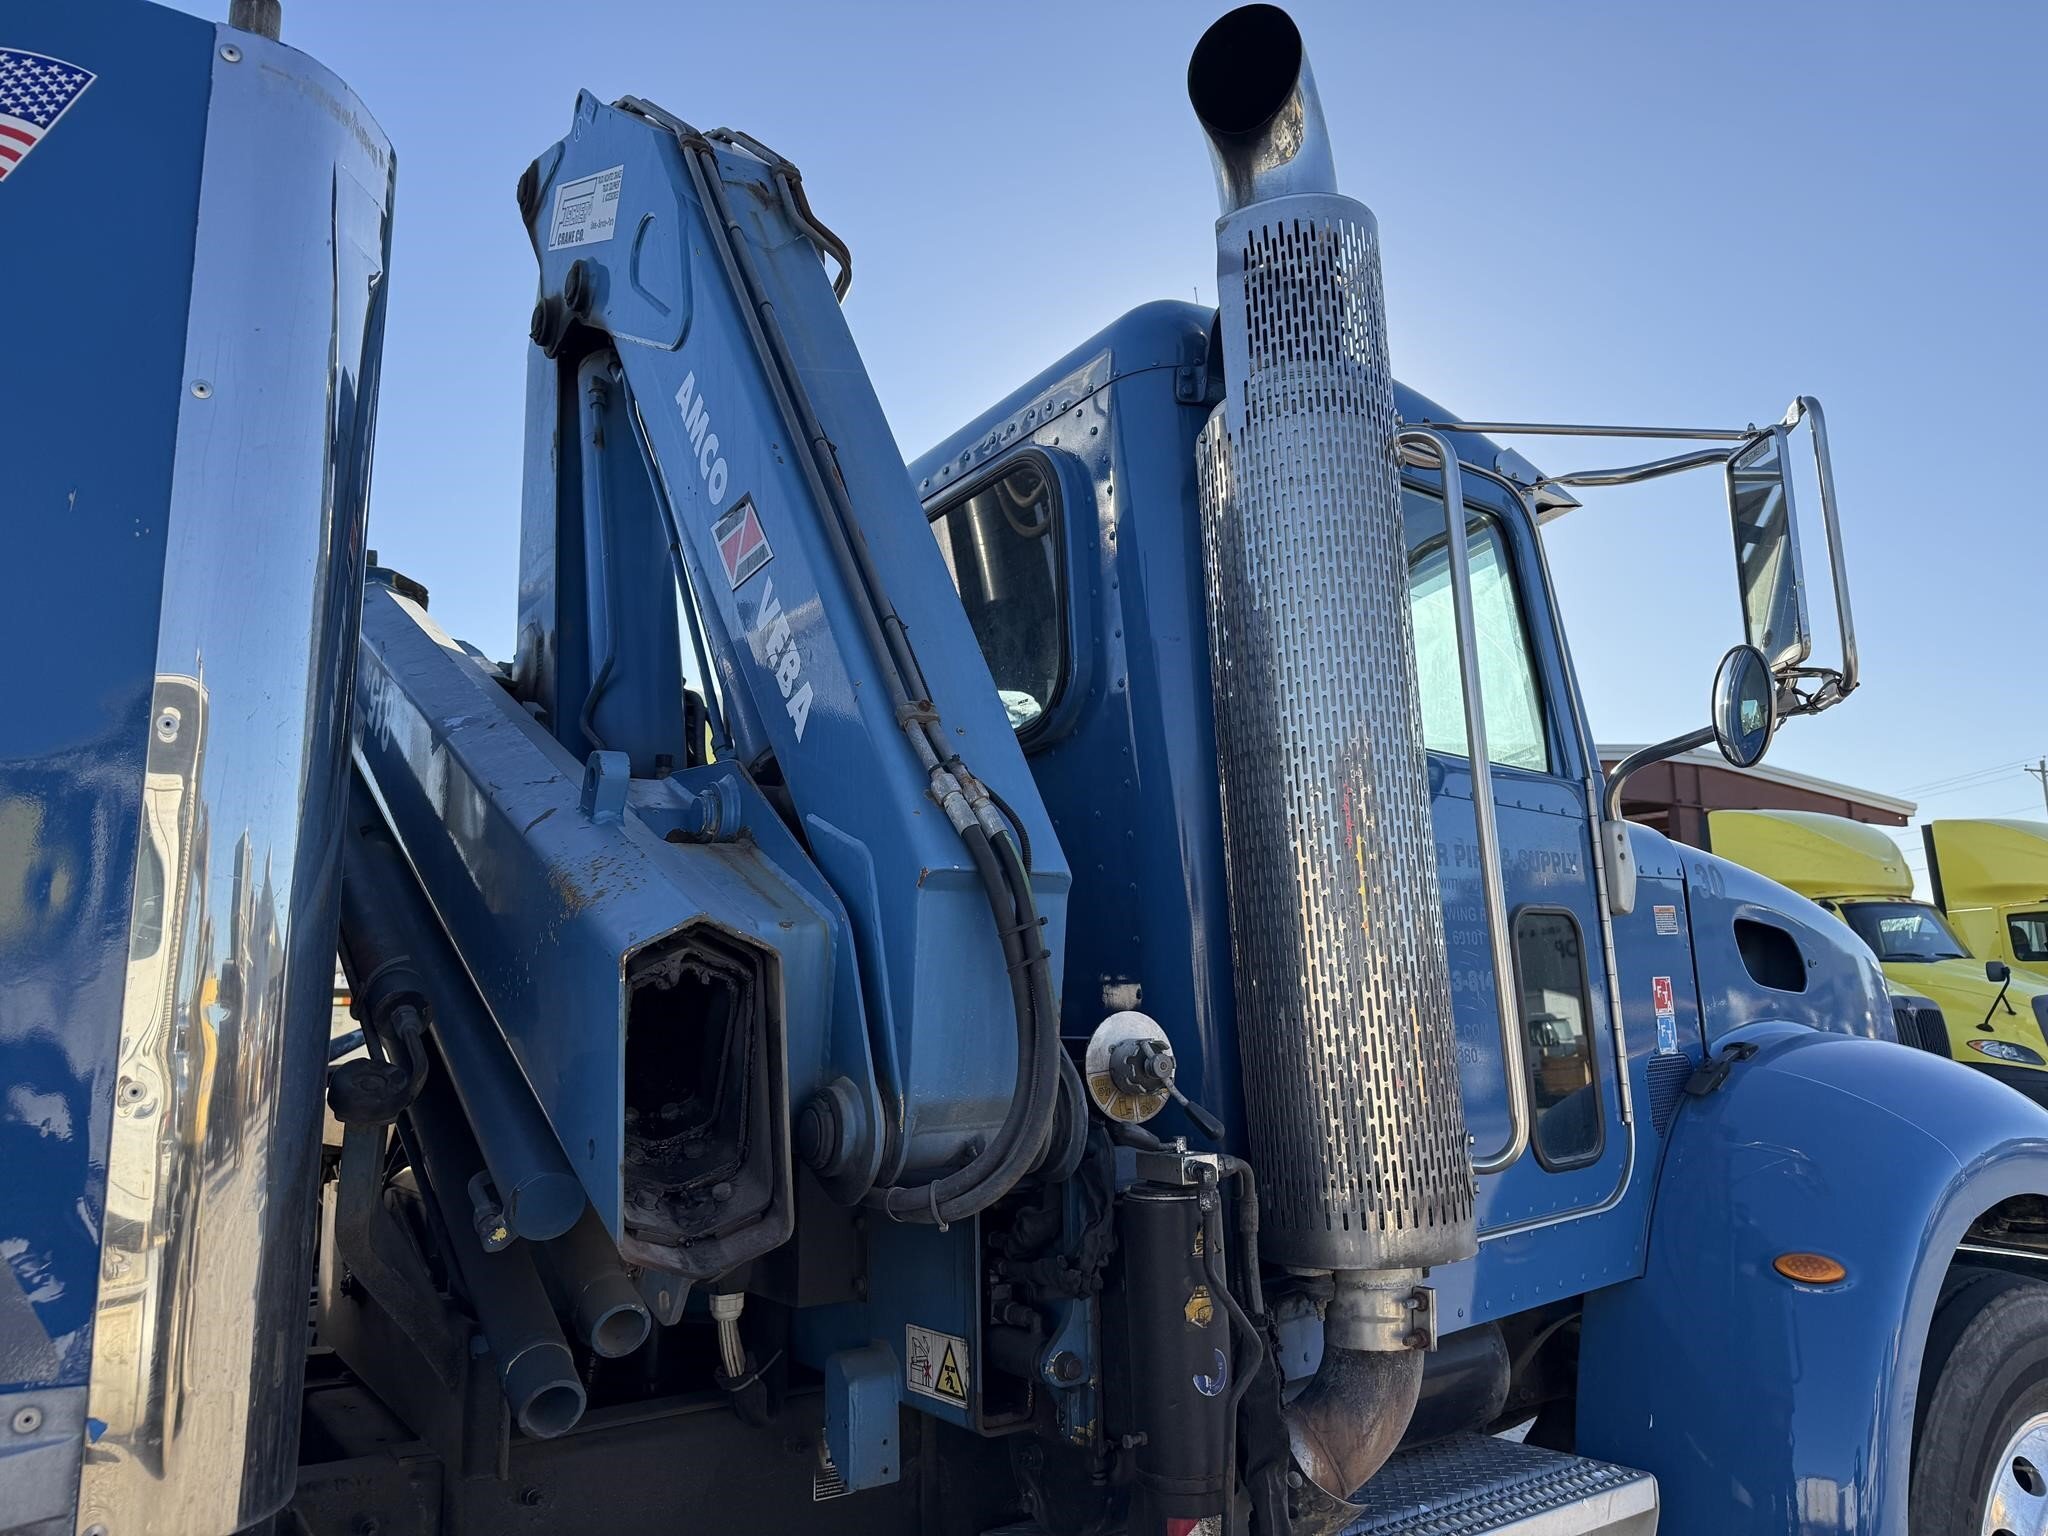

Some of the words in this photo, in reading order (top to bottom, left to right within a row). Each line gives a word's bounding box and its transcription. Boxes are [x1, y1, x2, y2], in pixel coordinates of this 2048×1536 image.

[675, 370, 728, 505] AMCO
[756, 576, 814, 743] VEBA
[1519, 848, 1578, 875] SUPPLY
